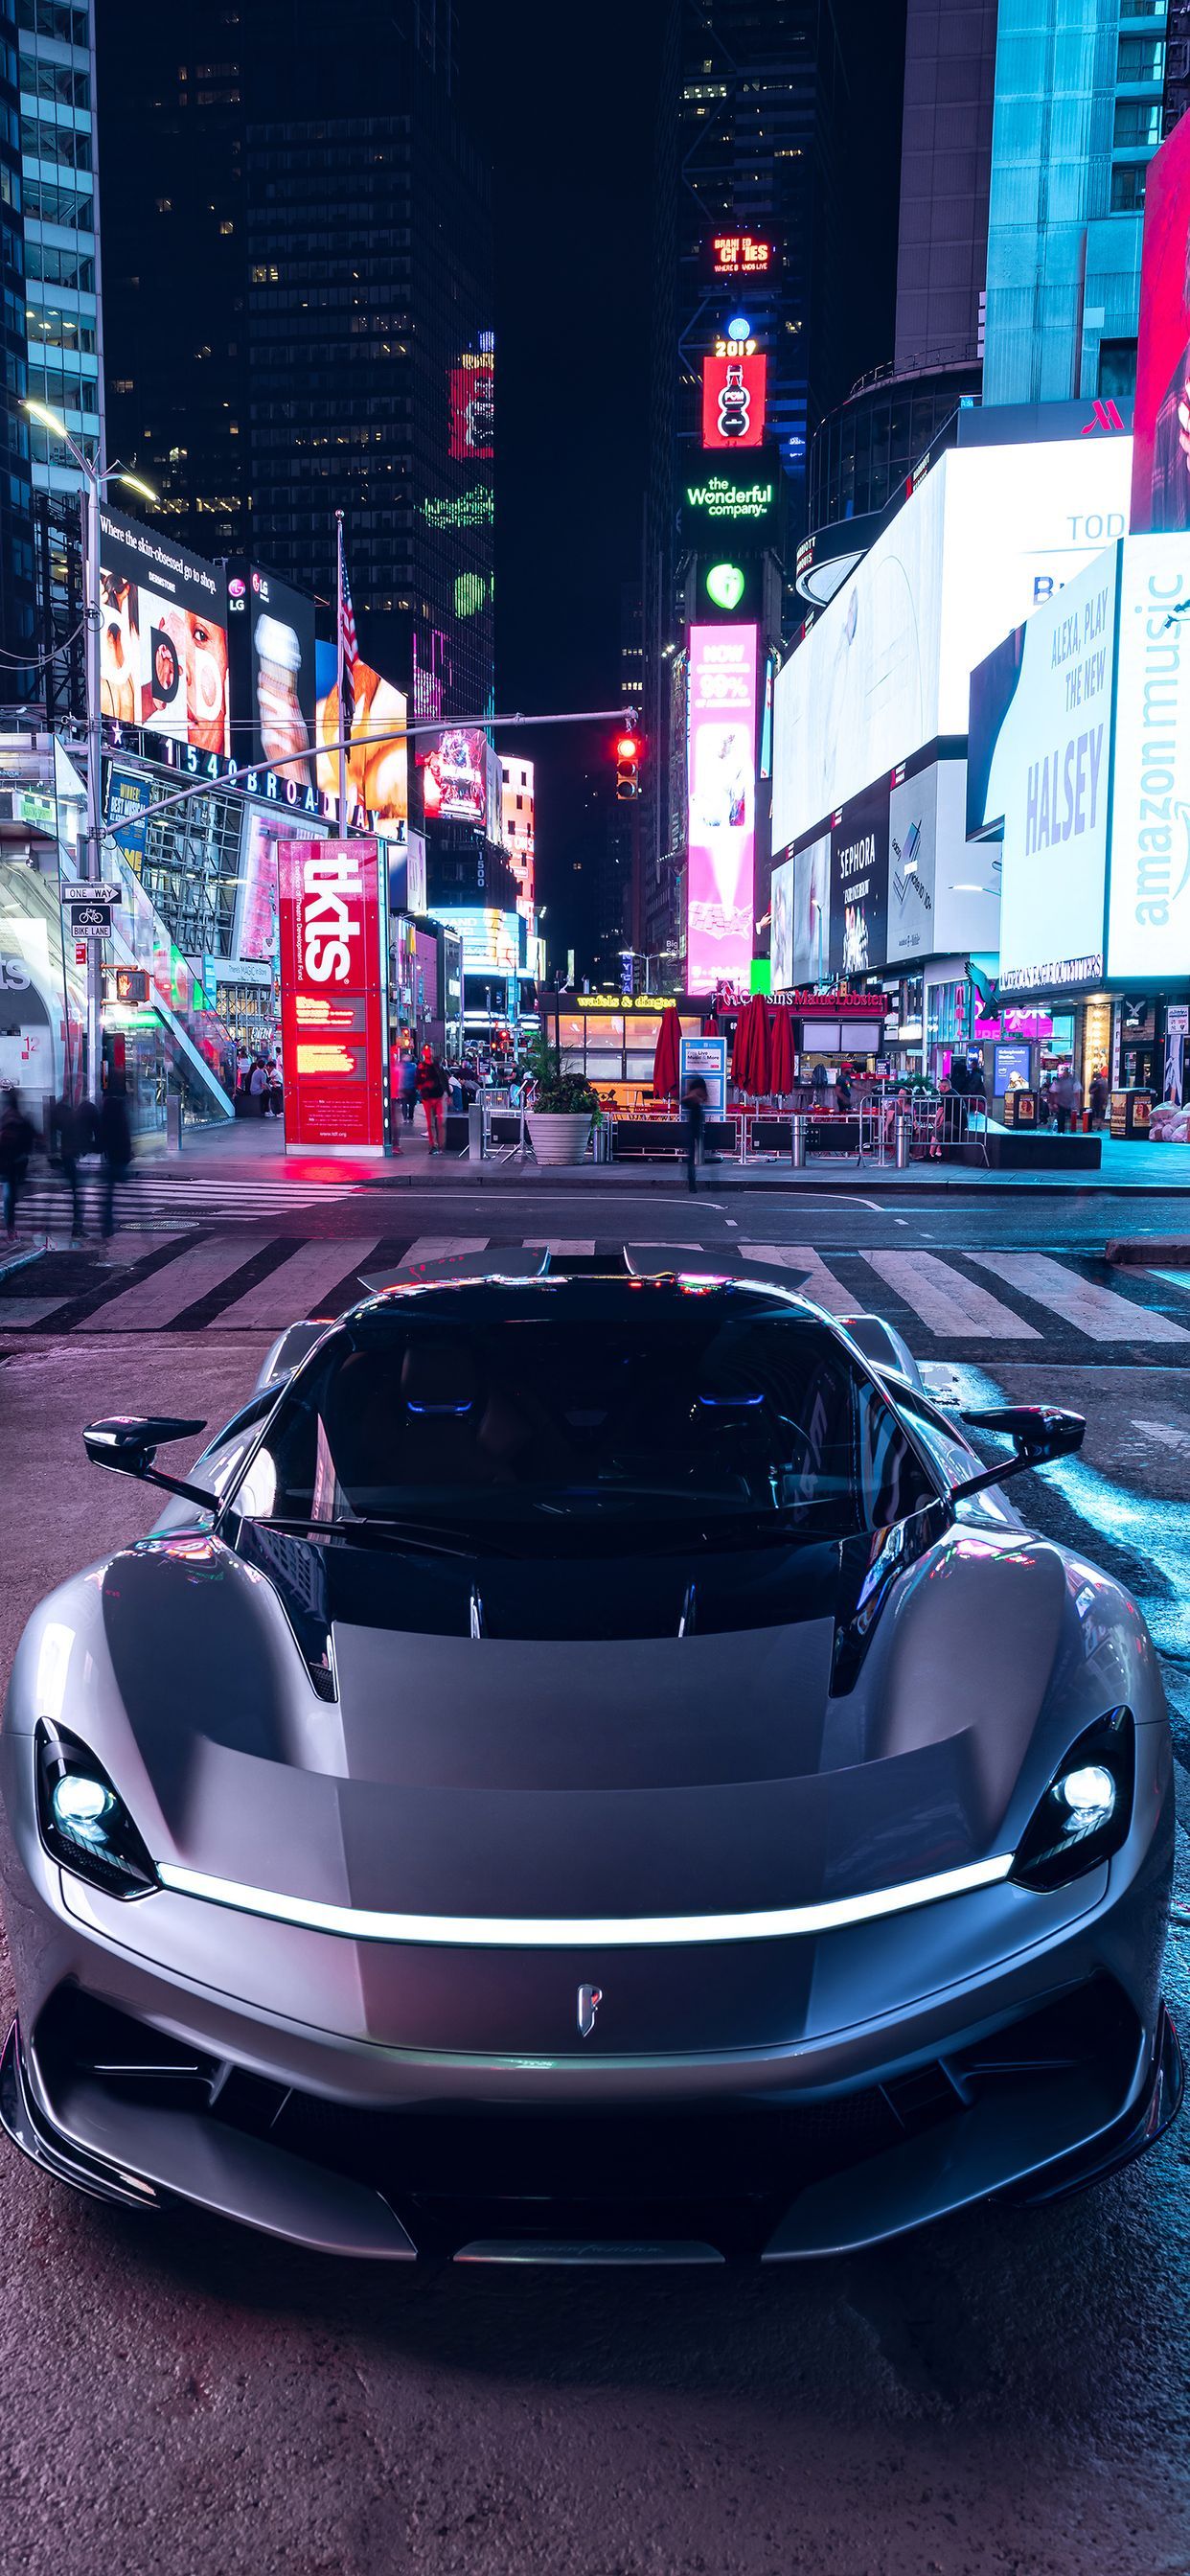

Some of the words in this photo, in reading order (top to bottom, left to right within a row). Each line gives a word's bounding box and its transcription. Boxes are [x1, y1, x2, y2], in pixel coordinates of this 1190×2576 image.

[714, 238, 751, 251] BRANED
[721, 244, 768, 263] CIIES
[715, 340, 756, 356] 2019
[708, 476, 728, 490] the
[687, 485, 771, 505] Wonderful
[708, 504, 763, 518] company
[100, 515, 125, 542] Where
[126, 529, 138, 549] the
[138, 538, 183, 574] skin-obsessed
[184, 565, 192, 581] go
[193, 568, 199, 583] to
[200, 570, 217, 594] shop.
[260, 579, 268, 595] LG
[230, 599, 245, 610] LG
[1051, 612, 1081, 670] ALEXA,
[1084, 586, 1109, 645] PLAY
[1134, 574, 1183, 728] music
[1065, 664, 1083, 712] THE
[1084, 647, 1107, 702] NEW
[165, 738, 238, 786] 1540
[1025, 724, 1104, 856] HALSEY
[1135, 739, 1177, 926] amazon
[840, 834, 876, 880] SEPHORA
[70, 888, 87, 898] ONE
[95, 888, 113, 898] WAY
[303, 853, 363, 982] tkts
[74, 927, 89, 935] BIKE
[91, 927, 108, 935] LANE
[999, 967, 1033, 992] AMERICAN
[1053, 954, 1103, 984] OUTFITTERS
[577, 995, 620, 1007] wafels
[621, 996, 632, 1007] &
[634, 995, 676, 1010] dinges
[835, 990, 884, 1005] Lobster
